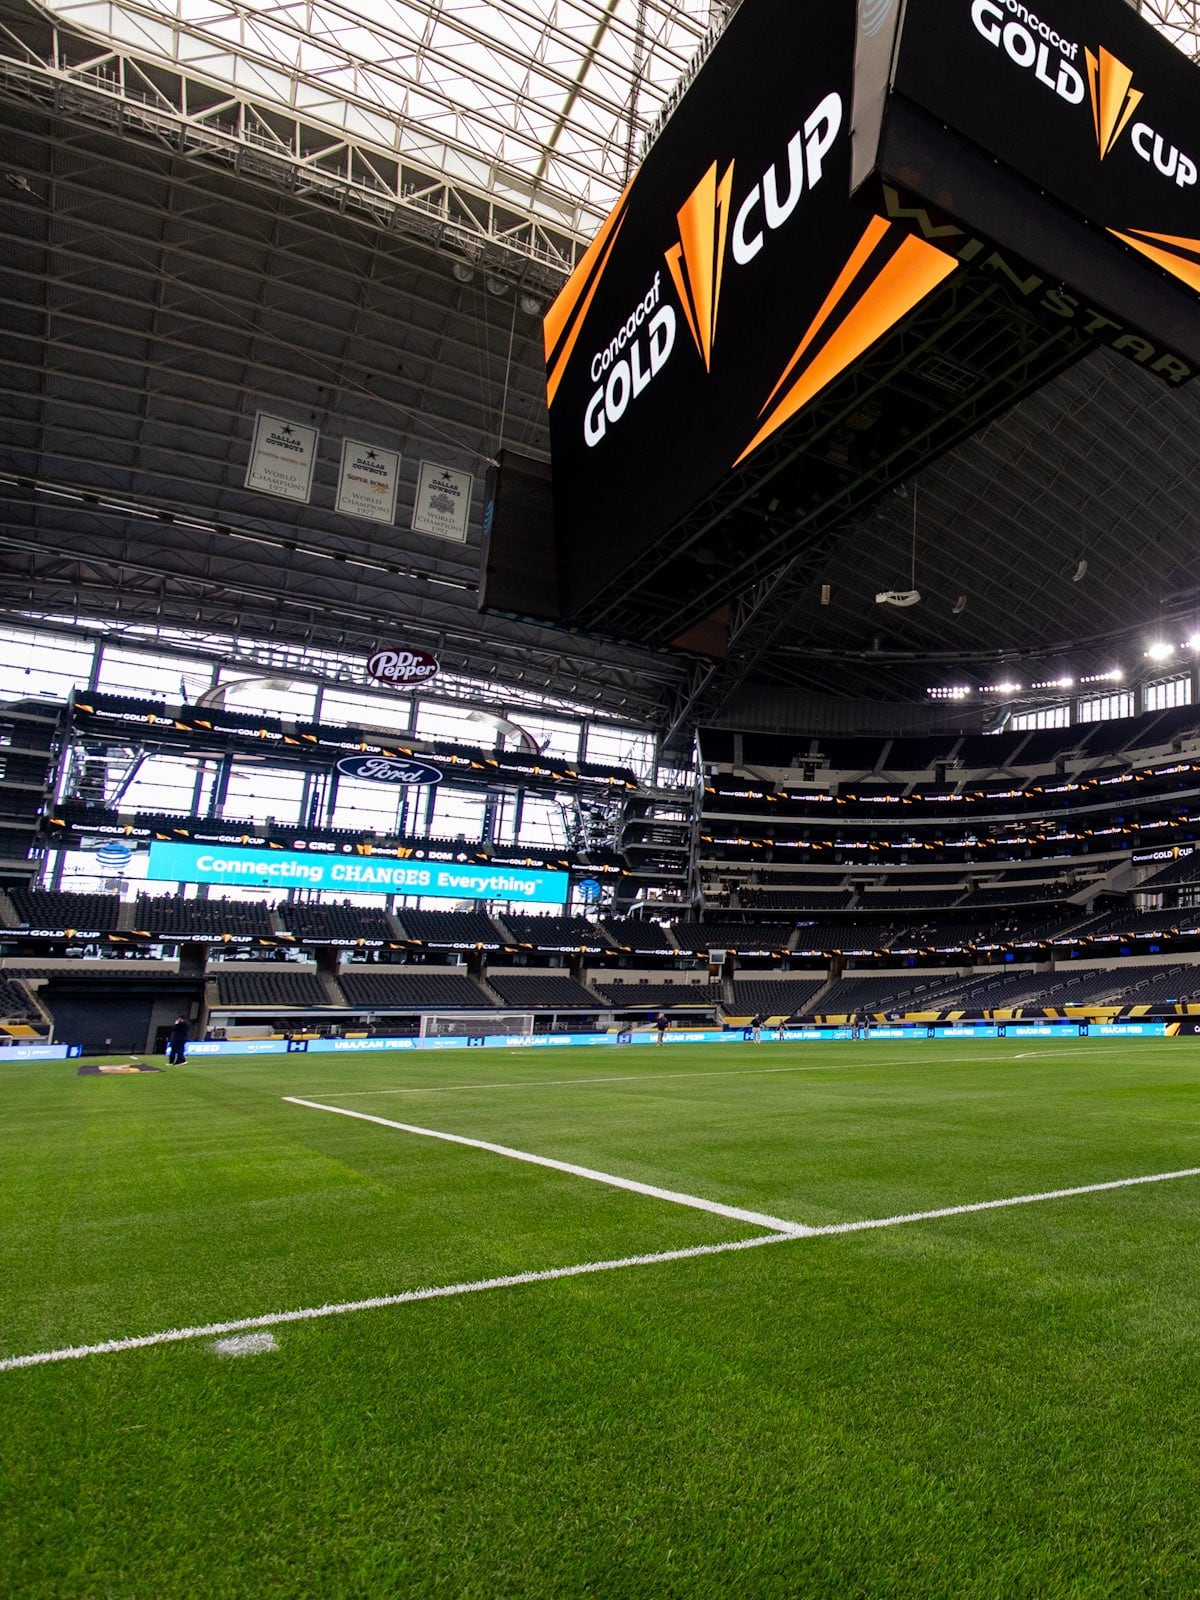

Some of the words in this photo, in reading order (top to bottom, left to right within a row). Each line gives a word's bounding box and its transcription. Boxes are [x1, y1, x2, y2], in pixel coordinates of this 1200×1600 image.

[999, 0, 1078, 60] oncacaf
[971, 0, 1085, 104] GOLD
[1131, 122, 1197, 188] CUP
[731, 92, 843, 265] CUP
[881, 182, 1193, 386] WINSTAR
[591, 270, 661, 382] Concacaf
[583, 304, 677, 447] GOLD
[266, 438, 304, 453] COWBOYS
[271, 433, 302, 446] DALLAS
[353, 464, 388, 477] COWBOYS
[357, 459, 385, 470] DALLAS
[252, 472, 306, 492] CHAMPIONS
[264, 468, 297, 482] WORLD
[428, 484, 461, 497] COWBOYS
[433, 479, 459, 490] DALLAS
[341, 496, 390, 513] CHAMPIONS
[352, 492, 382, 505] WORLD
[417, 516, 462, 532] CHAMPIONS
[427, 512, 455, 524] WORLD
[369, 651, 436, 680] Pepper
[396, 651, 423, 667] Dr
[357, 763, 425, 784] Ford
[99, 826, 125, 835] GOLD
[309, 841, 336, 851] CRC
[428, 852, 453, 860] DOM
[196, 855, 324, 881] Connecting
[331, 864, 431, 886] CHANGES
[30, 929, 65, 938] GOLD
[75, 931, 101, 939] CUP
[192, 934, 222, 943] GOLD
[231, 935, 253, 943] CUP
[331, 939, 357, 947] GOLD
[334, 1041, 384, 1050] USA/CAN
[386, 1040, 414, 1049] FEED
